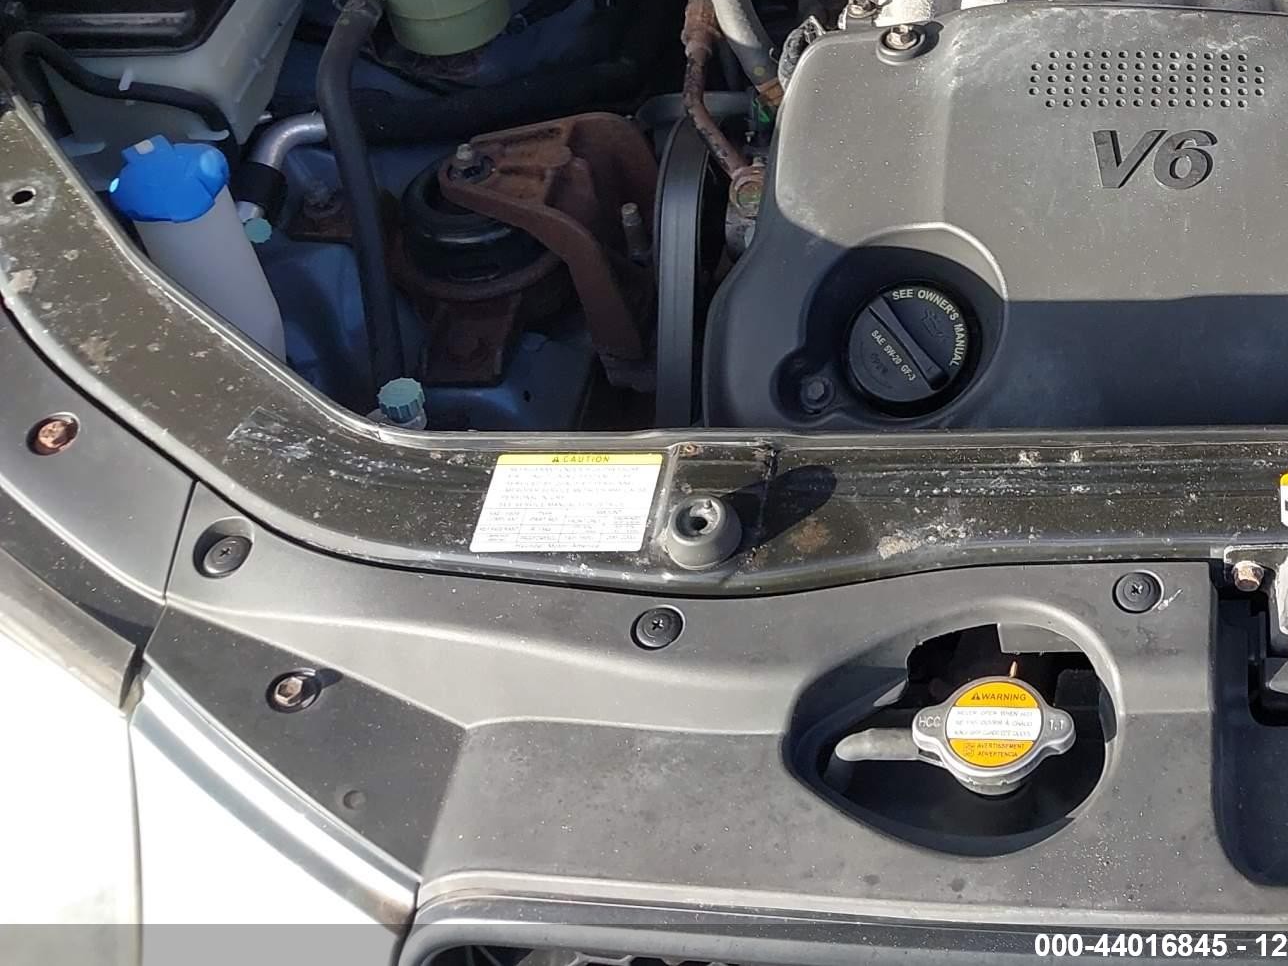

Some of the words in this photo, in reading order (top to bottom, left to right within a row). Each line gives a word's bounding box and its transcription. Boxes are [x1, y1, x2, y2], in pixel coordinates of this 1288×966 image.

[1092, 129, 1218, 190] V6
[892, 288, 914, 301] SEE
[917, 289, 960, 321] OWNER'S
[949, 323, 966, 366] MANUAL
[871, 329, 887, 346] SAE
[883, 344, 903, 365] 5W-20
[563, 455, 610, 464] CAUTION
[981, 692, 1027, 702] WARNING
[918, 716, 941, 729] HCC
[1049, 719, 1065, 731] 1.1
